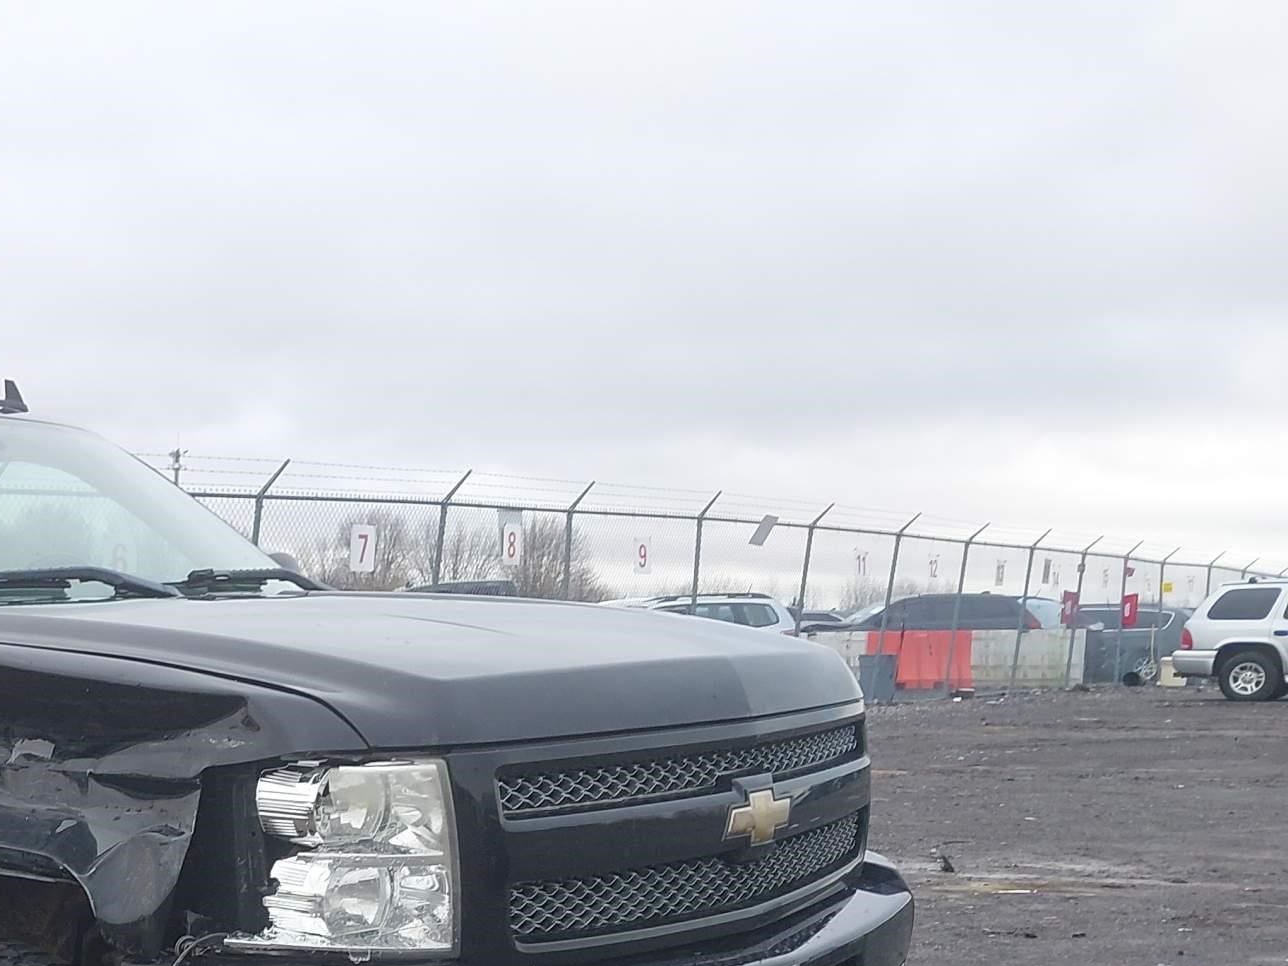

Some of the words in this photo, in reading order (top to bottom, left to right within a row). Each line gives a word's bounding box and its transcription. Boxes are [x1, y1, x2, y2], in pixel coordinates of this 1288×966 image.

[358, 534, 369, 564] 7
[507, 531, 517, 558] 8
[638, 543, 647, 568] 9
[929, 559, 938, 578] 12
